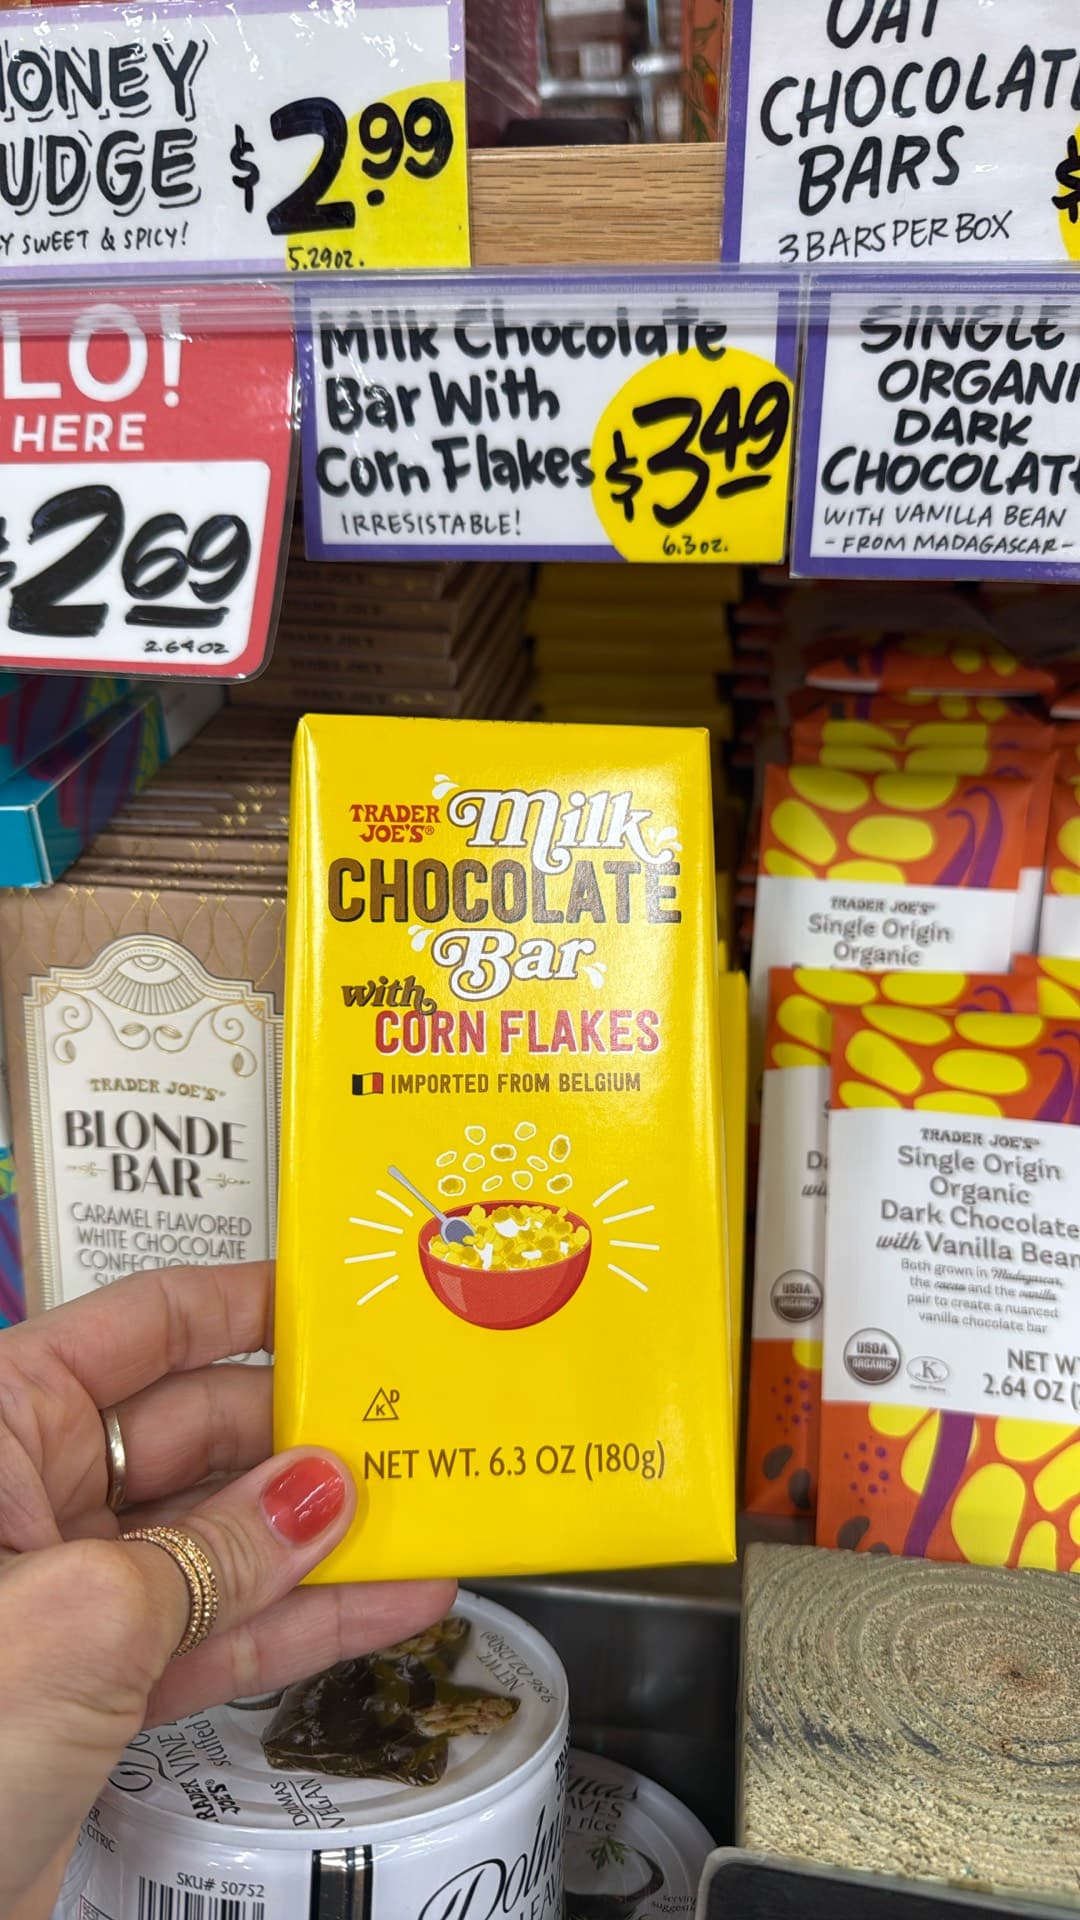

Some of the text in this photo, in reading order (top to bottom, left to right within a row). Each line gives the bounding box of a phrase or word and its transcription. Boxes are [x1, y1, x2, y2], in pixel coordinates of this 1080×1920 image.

[0, 38, 208, 121] ONEY
[798, 125, 964, 216] BARS
[22, 229, 89, 255] SWEET
[101, 227, 116, 251] &
[124, 222, 188, 249] SPICY!
[779, 209, 1012, 263] 3 BARS PER BOX
[318, 299, 728, 368] Milk Chocolate
[860, 304, 1071, 353] SINGLE
[325, 366, 561, 433] Bar With
[13, 412, 147, 453] HERE
[894, 406, 1032, 449] DARK
[315, 434, 596, 497] Corn Flakes
[341, 512, 521, 537] IRRESISTABLE!
[824, 504, 1067, 529] WITH VANILLA BEAN
[349, 804, 440, 824] TRADER
[447, 789, 674, 874] Milk
[328, 857, 682, 924] CHOCOLATE
[808, 913, 952, 947] Single Origin
[431, 928, 595, 1001] Bar
[832, 941, 921, 968] Organic
[341, 975, 438, 1016] with
[375, 1009, 662, 1056] CORN FLAKES
[88, 1077, 161, 1093] TRADER
[391, 1071, 642, 1095] IMPORTED FROM BELGIUM
[64, 1110, 248, 1163] BLONDE
[920, 1128, 983, 1147] TRADER
[112, 1152, 203, 1199] BAR
[898, 1144, 1064, 1184] Single Origin
[930, 1175, 1032, 1206] Organic
[70, 1202, 252, 1238] CARAMEL FLAVORED
[880, 1198, 1080, 1239] Dark Chocolate
[77, 1226, 246, 1260] WHITE CHOCOLATE
[876, 1230, 922, 1251] with
[924, 1230, 1013, 1262] Vanilla
[901, 1257, 931, 1273] Both
[976, 1265, 989, 1279] in
[909, 1276, 931, 1288] the
[968, 1282, 993, 1296] and
[995, 1284, 1018, 1298] the
[907, 1292, 1060, 1319] pair to create a nuanced
[919, 1310, 1049, 1335] vanilla chocolate bar
[1007, 1347, 1049, 1373] NET
[983, 1371, 1027, 1398] 2.64
[1033, 1378, 1066, 1403] OZ
[364, 1440, 666, 1481] NET WT. 6.3 OZ (180g)
[157, 1732, 200, 1778] VINE
[184, 1719, 233, 1768] stuffed
[180, 1778, 221, 1823] RADER
[295, 1778, 346, 1829] VEGAN
[86, 1824, 117, 1853] CITRIC
[177, 1871, 265, 1898] SKU# 50752
